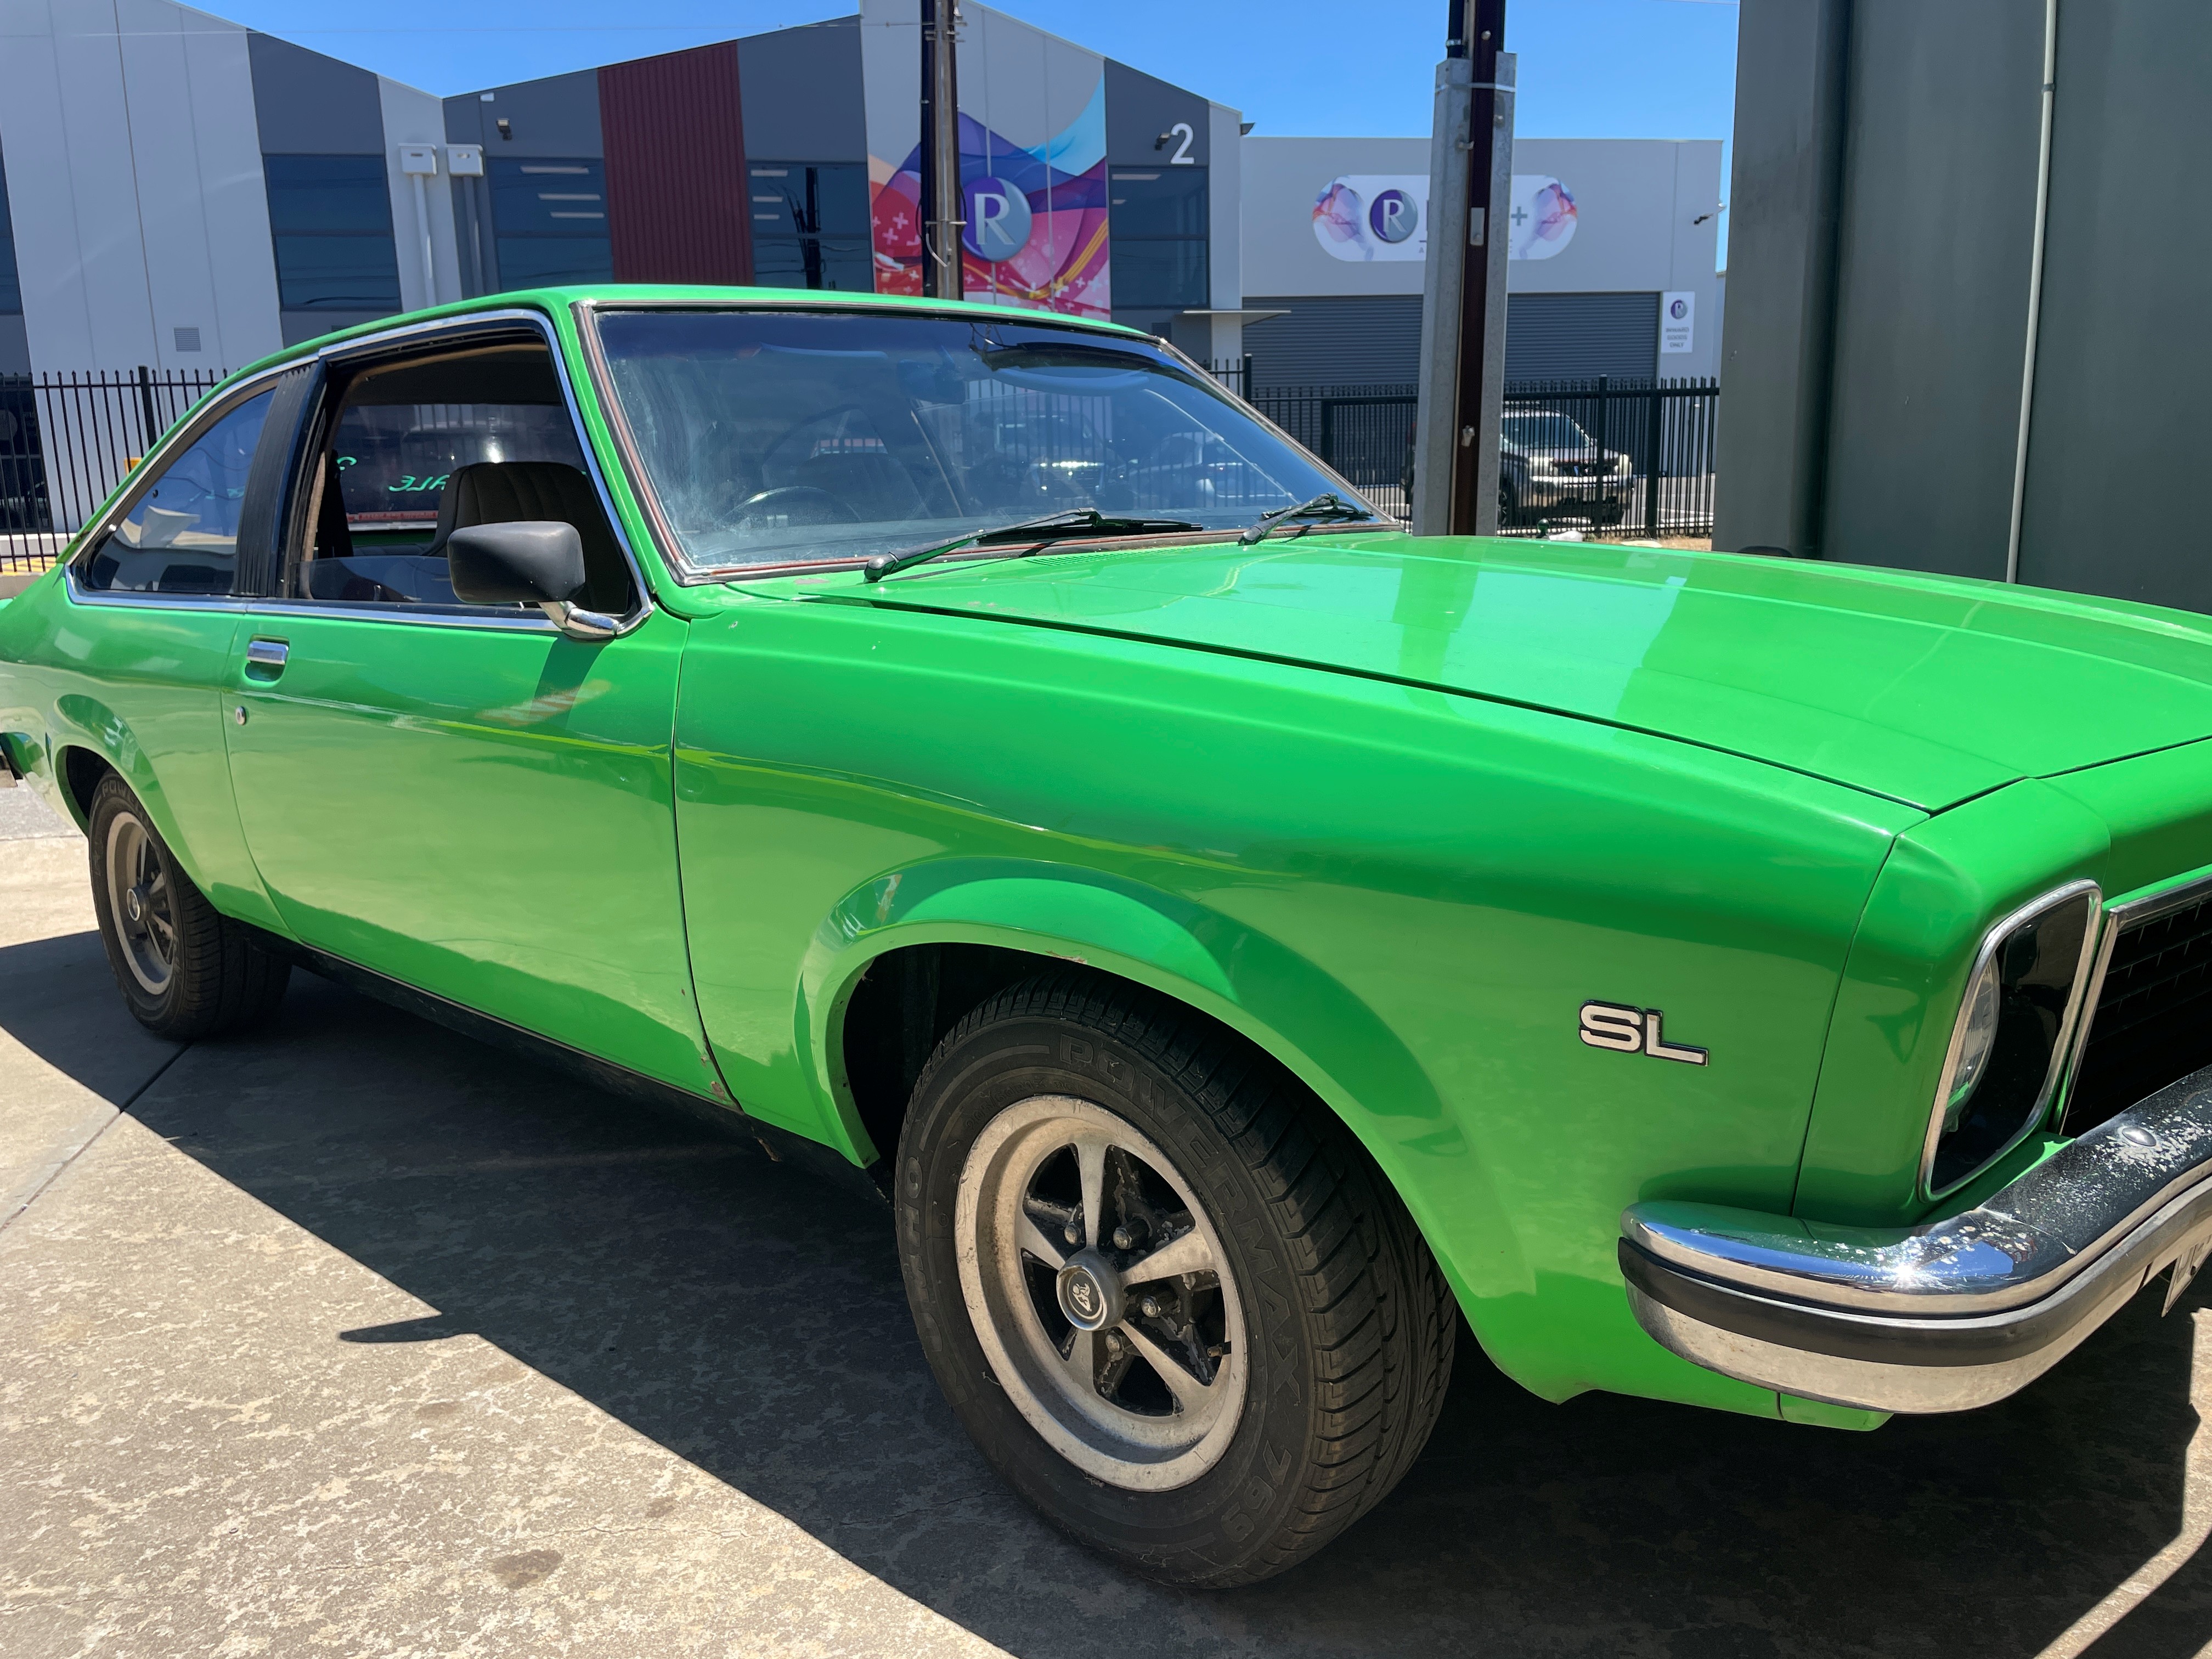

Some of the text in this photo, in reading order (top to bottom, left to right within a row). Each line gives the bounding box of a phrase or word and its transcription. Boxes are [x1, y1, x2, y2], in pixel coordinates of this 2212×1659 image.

[1170, 122, 1195, 165] 2
[974, 193, 1016, 246] R
[1383, 199, 1406, 233] R
[1579, 1000, 1708, 1067] SL
[1058, 1032, 1301, 1398] POWERMAX
[901, 1156, 969, 1406] KUMHO
[1220, 1439, 1293, 1543] 769
